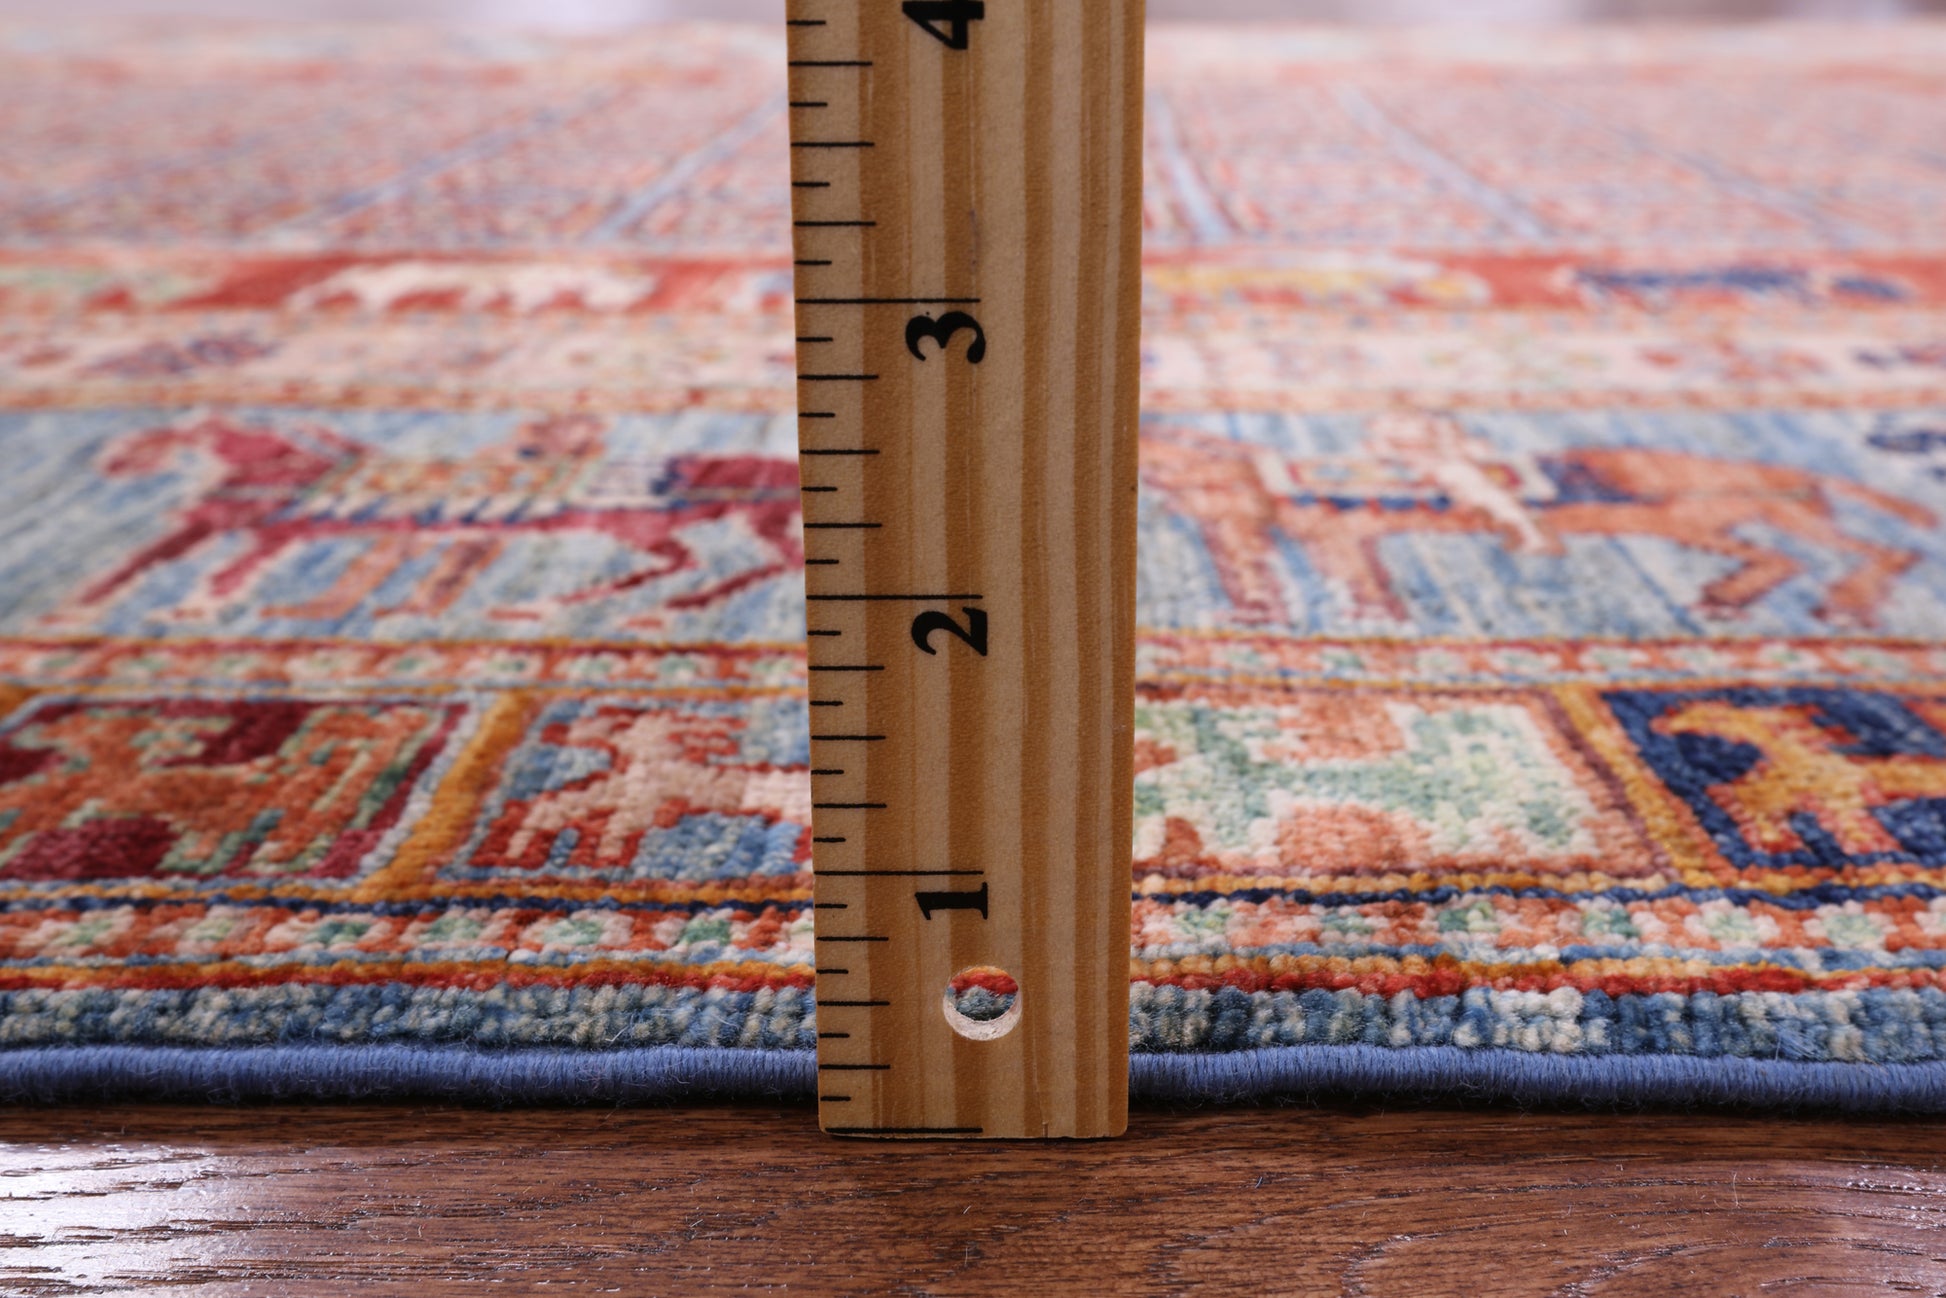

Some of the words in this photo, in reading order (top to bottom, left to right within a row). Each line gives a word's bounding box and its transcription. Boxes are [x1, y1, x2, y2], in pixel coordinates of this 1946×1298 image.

[902, 0, 984, 50] 4
[905, 311, 986, 364] 3
[911, 607, 988, 657] 2
[914, 882, 989, 921] 1
